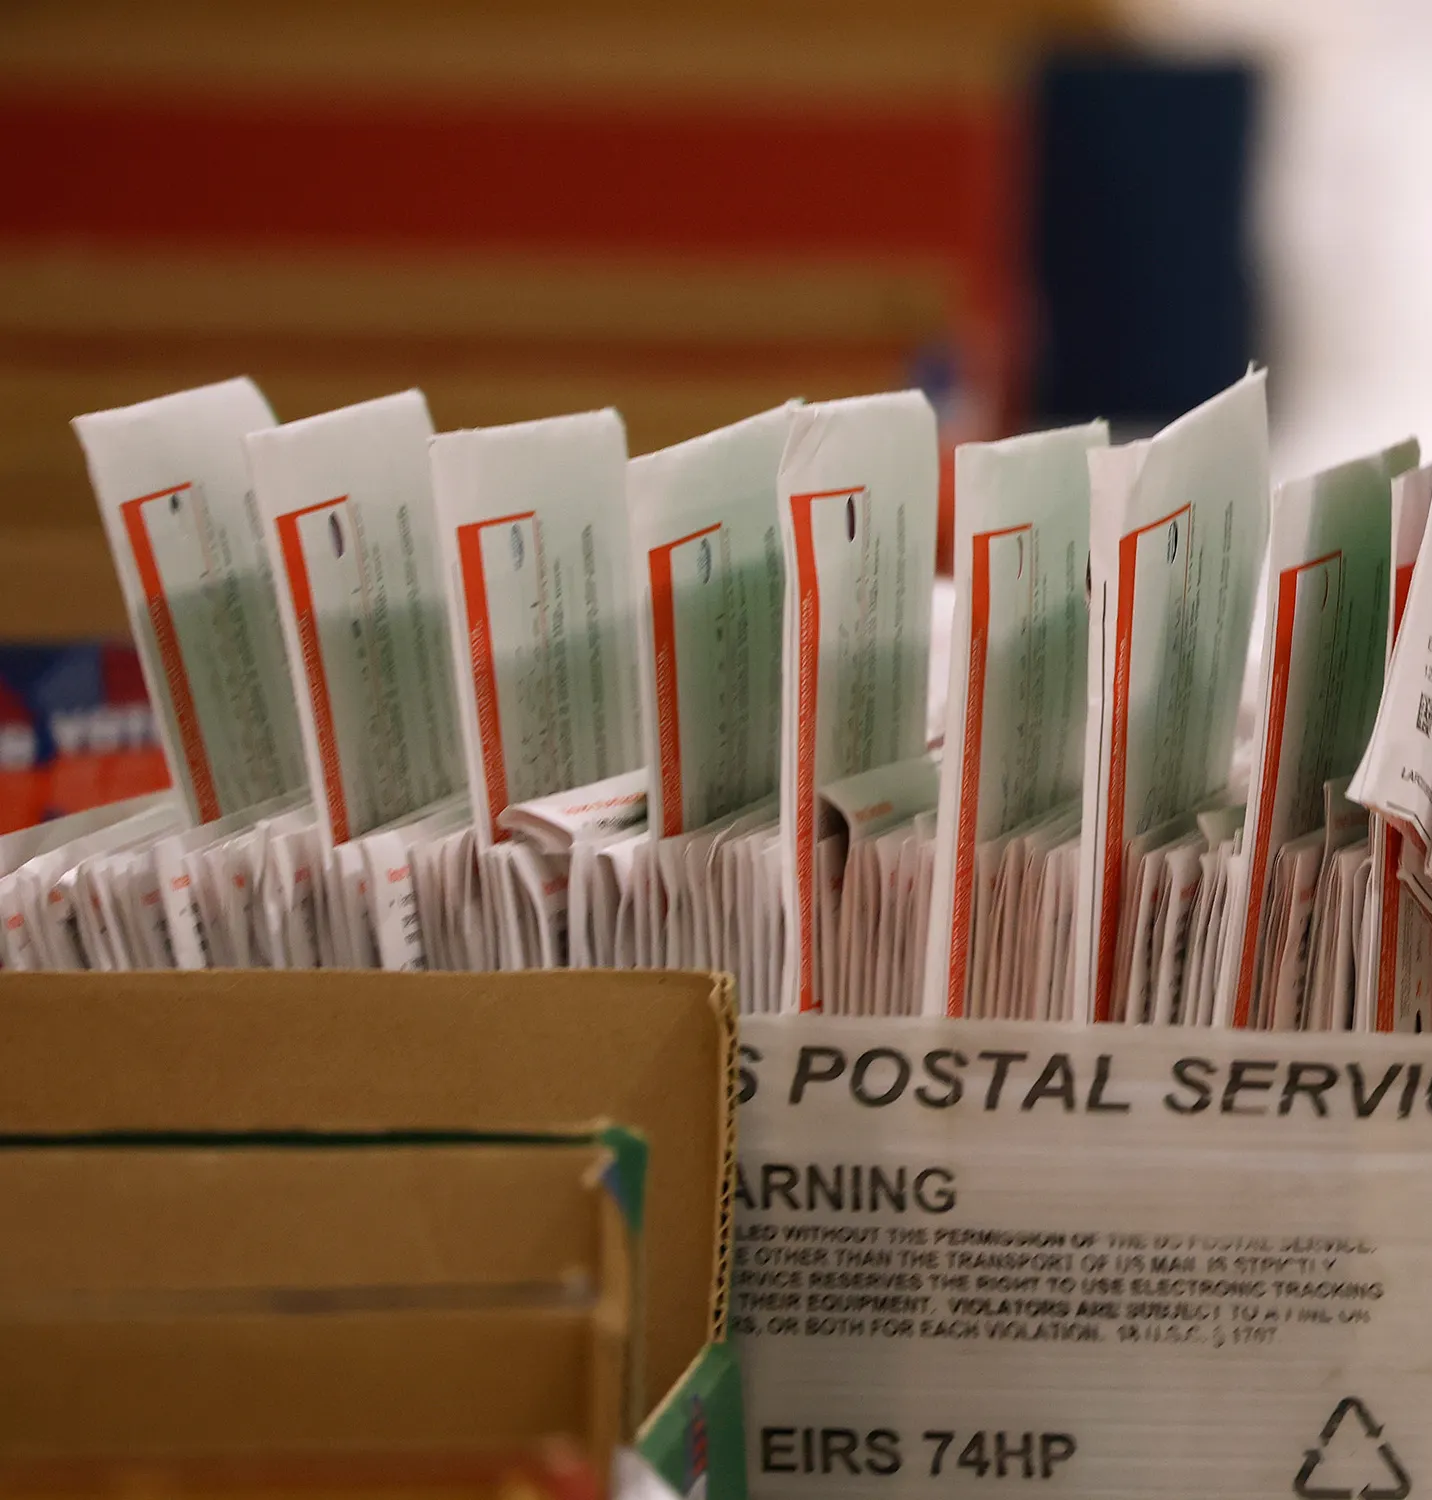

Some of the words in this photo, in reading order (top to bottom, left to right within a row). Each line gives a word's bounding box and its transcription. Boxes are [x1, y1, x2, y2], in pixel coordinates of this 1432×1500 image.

[736, 1044, 763, 1106] S
[788, 1045, 1131, 1114] POSTAL
[734, 1161, 957, 1215] ARNING
[735, 1224, 778, 1242] LED
[782, 1226, 880, 1244] WITHOUT
[886, 1227, 929, 1246] THE
[933, 1228, 1066, 1248] PERMISSION
[1070, 1231, 1097, 1249] OF
[735, 1247, 749, 1265] E
[754, 1247, 829, 1266] OTHER
[834, 1248, 893, 1268] THAN
[897, 1250, 940, 1269] THE
[947, 1252, 1074, 1272] TRANSPORT
[1081, 1253, 1109, 1273] OF
[1115, 1254, 1147, 1274] US
[734, 1270, 802, 1289] RVICE
[808, 1271, 924, 1291] RESERVES
[928, 1273, 971, 1292] THE
[976, 1274, 1041, 1293] RIGHT
[1046, 1276, 1077, 1294] TO
[1081, 1276, 1125, 1295] USE
[1130, 1277, 1267, 1298] ELECTRONIC
[1272, 1280, 1385, 1300] TRACKING
[947, 1297, 1071, 1318] VIOLATORS
[1075, 1300, 1119, 1319] ARE
[731, 1314, 762, 1337] RS,
[767, 1315, 799, 1336] OR
[805, 1316, 866, 1337] BOTH
[870, 1318, 915, 1338] FOR
[920, 1319, 980, 1339] EACH
[760, 1427, 903, 1477] EIRS
[921, 1430, 1078, 1480] 74HP
